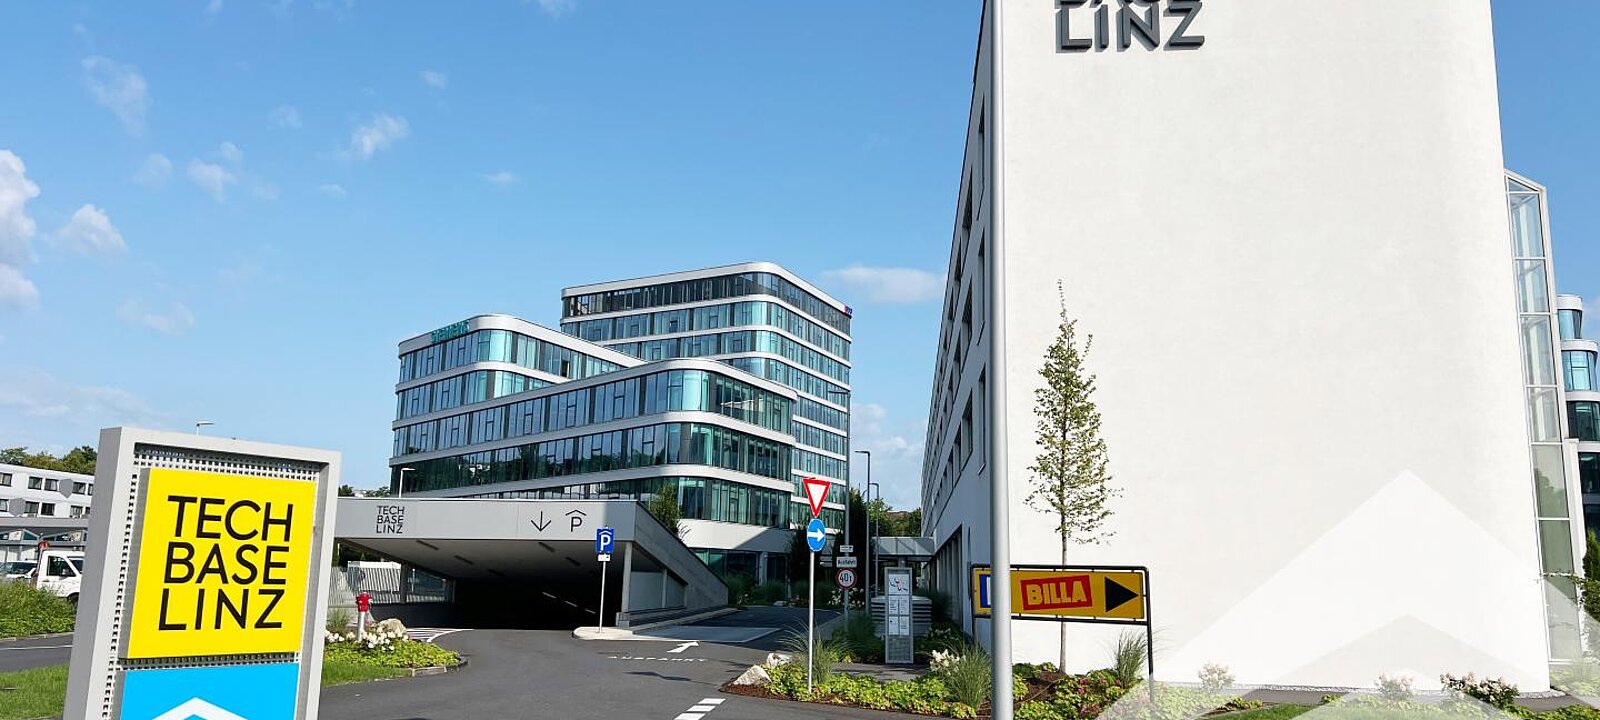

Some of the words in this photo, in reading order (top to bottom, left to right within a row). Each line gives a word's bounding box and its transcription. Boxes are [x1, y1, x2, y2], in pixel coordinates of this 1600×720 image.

[1055, 1, 1205, 53] LINZ
[167, 495, 294, 542] TECH
[376, 505, 405, 515] TECH
[376, 515, 404, 525] BASE
[570, 517, 583, 533] P
[376, 524, 403, 534] LINZ
[600, 534, 611, 551] P
[163, 541, 290, 585] BASE
[839, 572, 853, 583] 40t
[1026, 580, 1087, 606] BILLA
[158, 588, 286, 631] LINZ
